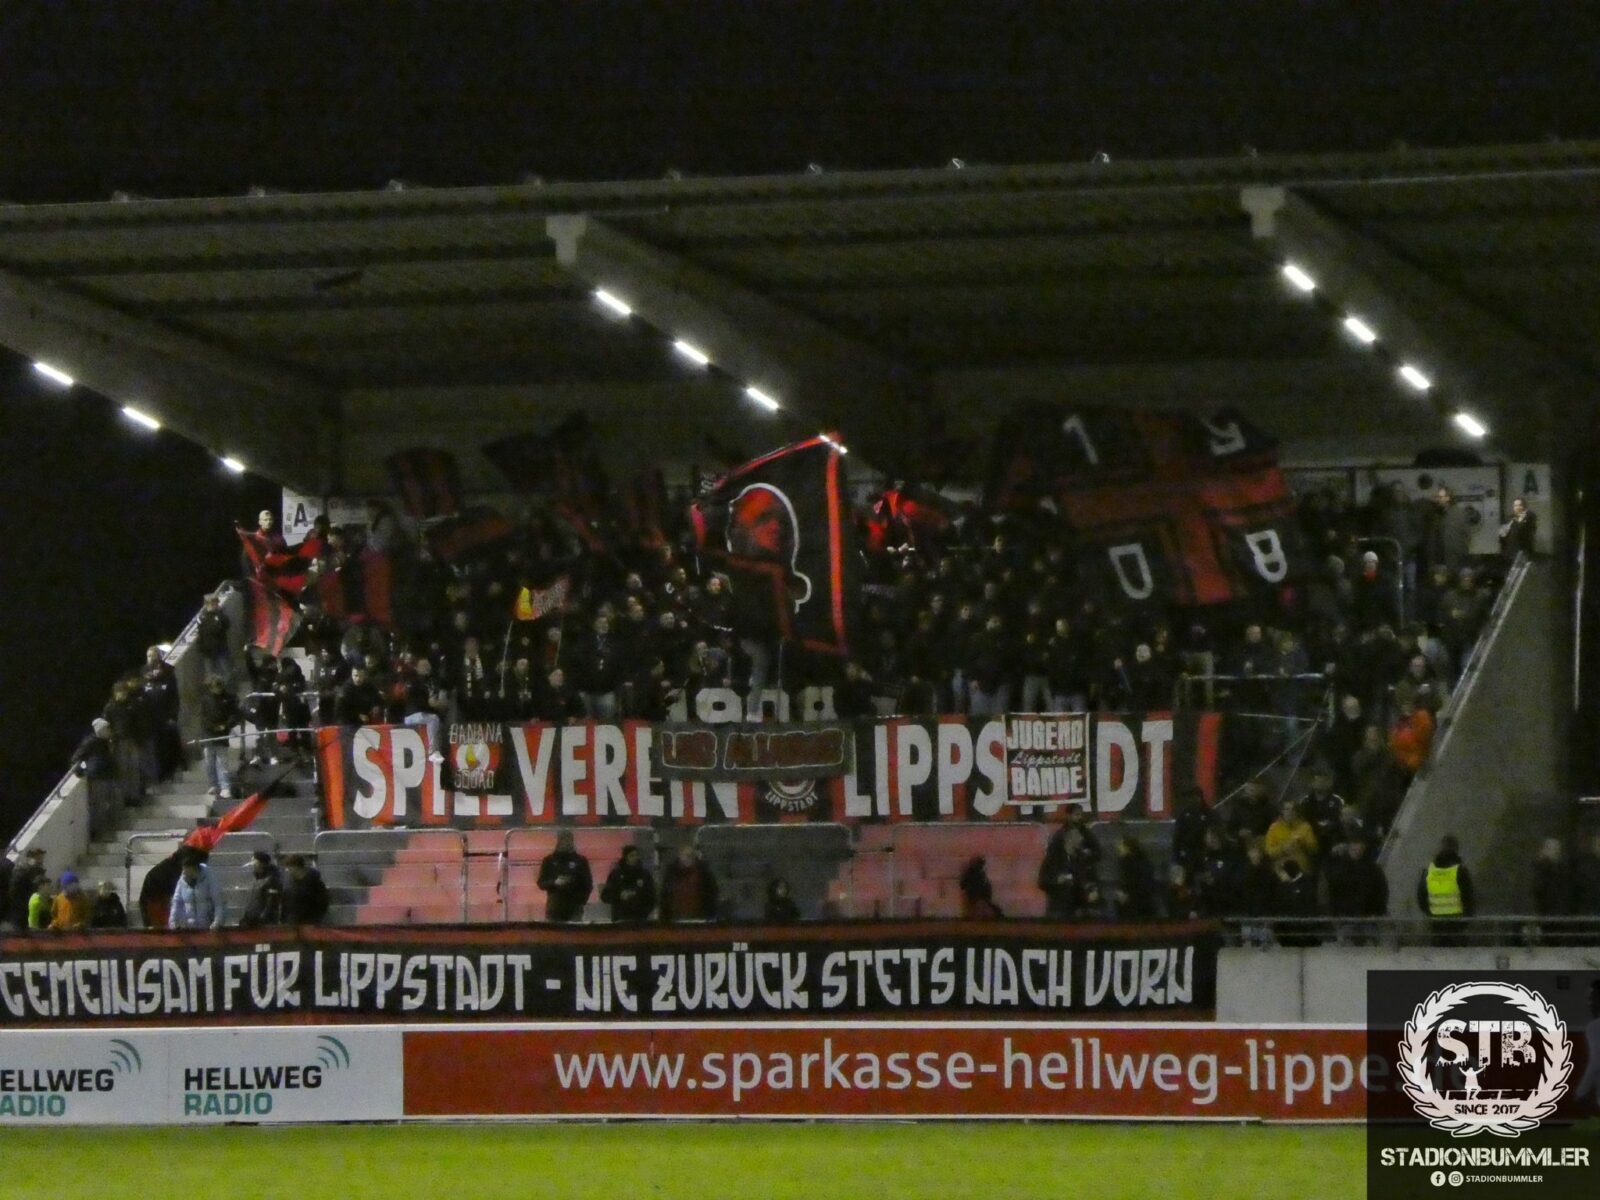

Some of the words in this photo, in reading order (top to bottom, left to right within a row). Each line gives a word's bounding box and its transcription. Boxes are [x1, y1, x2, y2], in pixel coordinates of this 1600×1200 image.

[293, 502, 309, 528] A
[449, 723, 504, 744] BANANA
[1006, 719, 1084, 750] JUGEND
[845, 720, 1174, 816] LIPPSDT
[1011, 766, 1084, 796] BANDE
[0, 957, 214, 1016] GEMEINSAM
[223, 944, 300, 1011] FÜR
[314, 950, 532, 1011] LIPPSTADT
[575, 954, 638, 1012] NIE
[651, 942, 808, 1012] ZURÜCK
[822, 946, 956, 1007] STETS
[965, 946, 1073, 1007] NACH
[1086, 945, 1194, 1005] VORN
[0, 1069, 114, 1092] ELLWEG
[184, 1066, 322, 1091] HELLWEG
[0, 1094, 66, 1117] ADIO
[184, 1092, 273, 1116] RADIO
